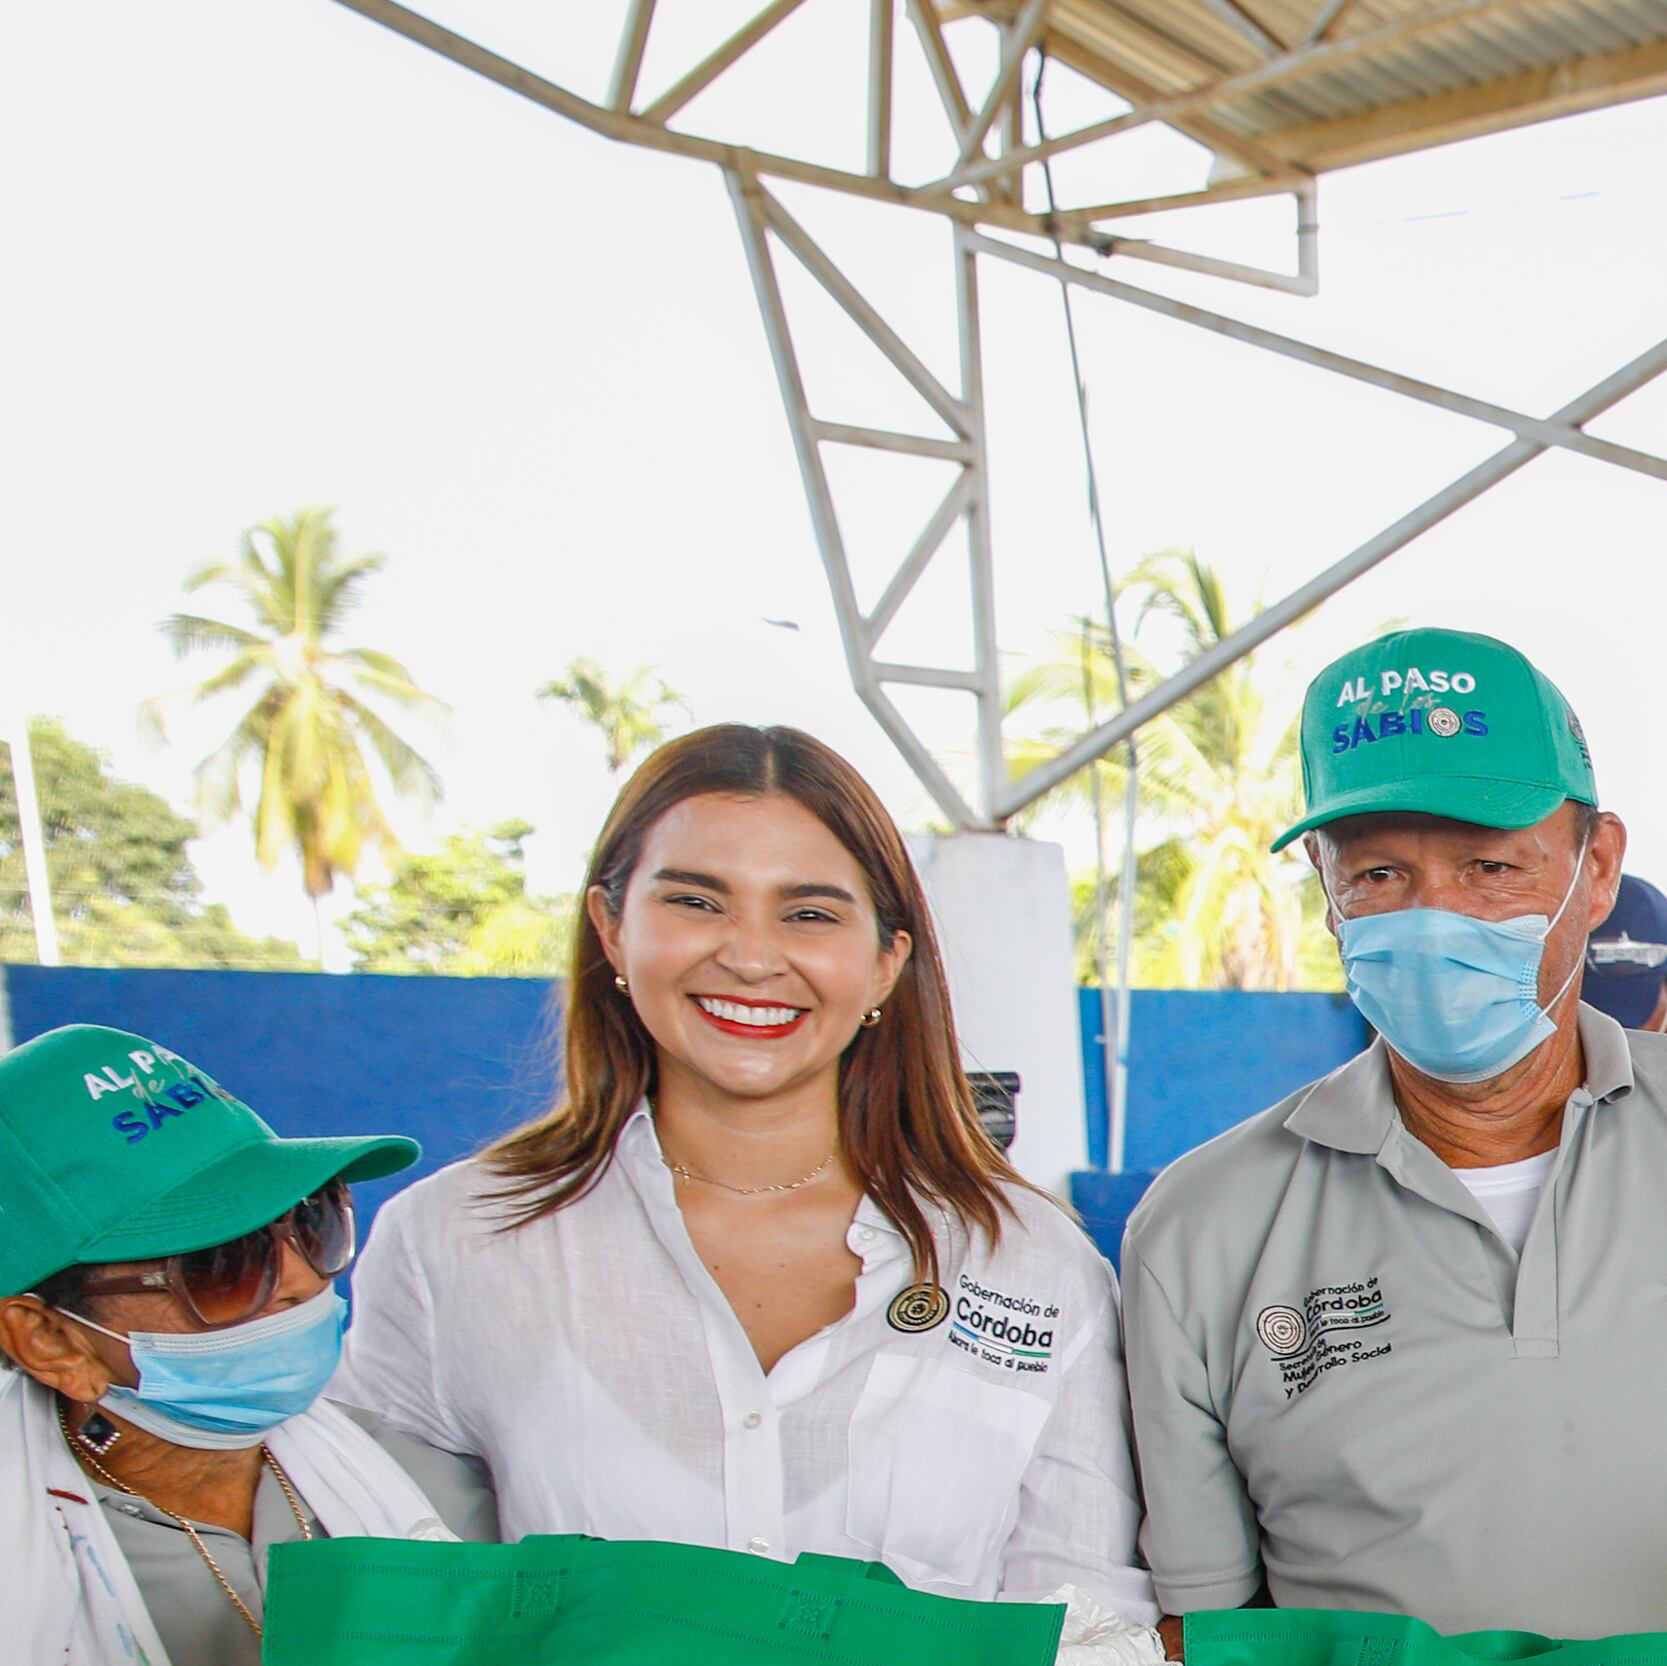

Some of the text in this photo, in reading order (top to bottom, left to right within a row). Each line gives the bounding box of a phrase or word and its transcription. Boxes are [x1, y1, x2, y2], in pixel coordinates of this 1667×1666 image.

[1337, 668, 1476, 707] AL PASO
[956, 1297, 1053, 1348] Córdoba
[1044, 1304, 1060, 1318] de
